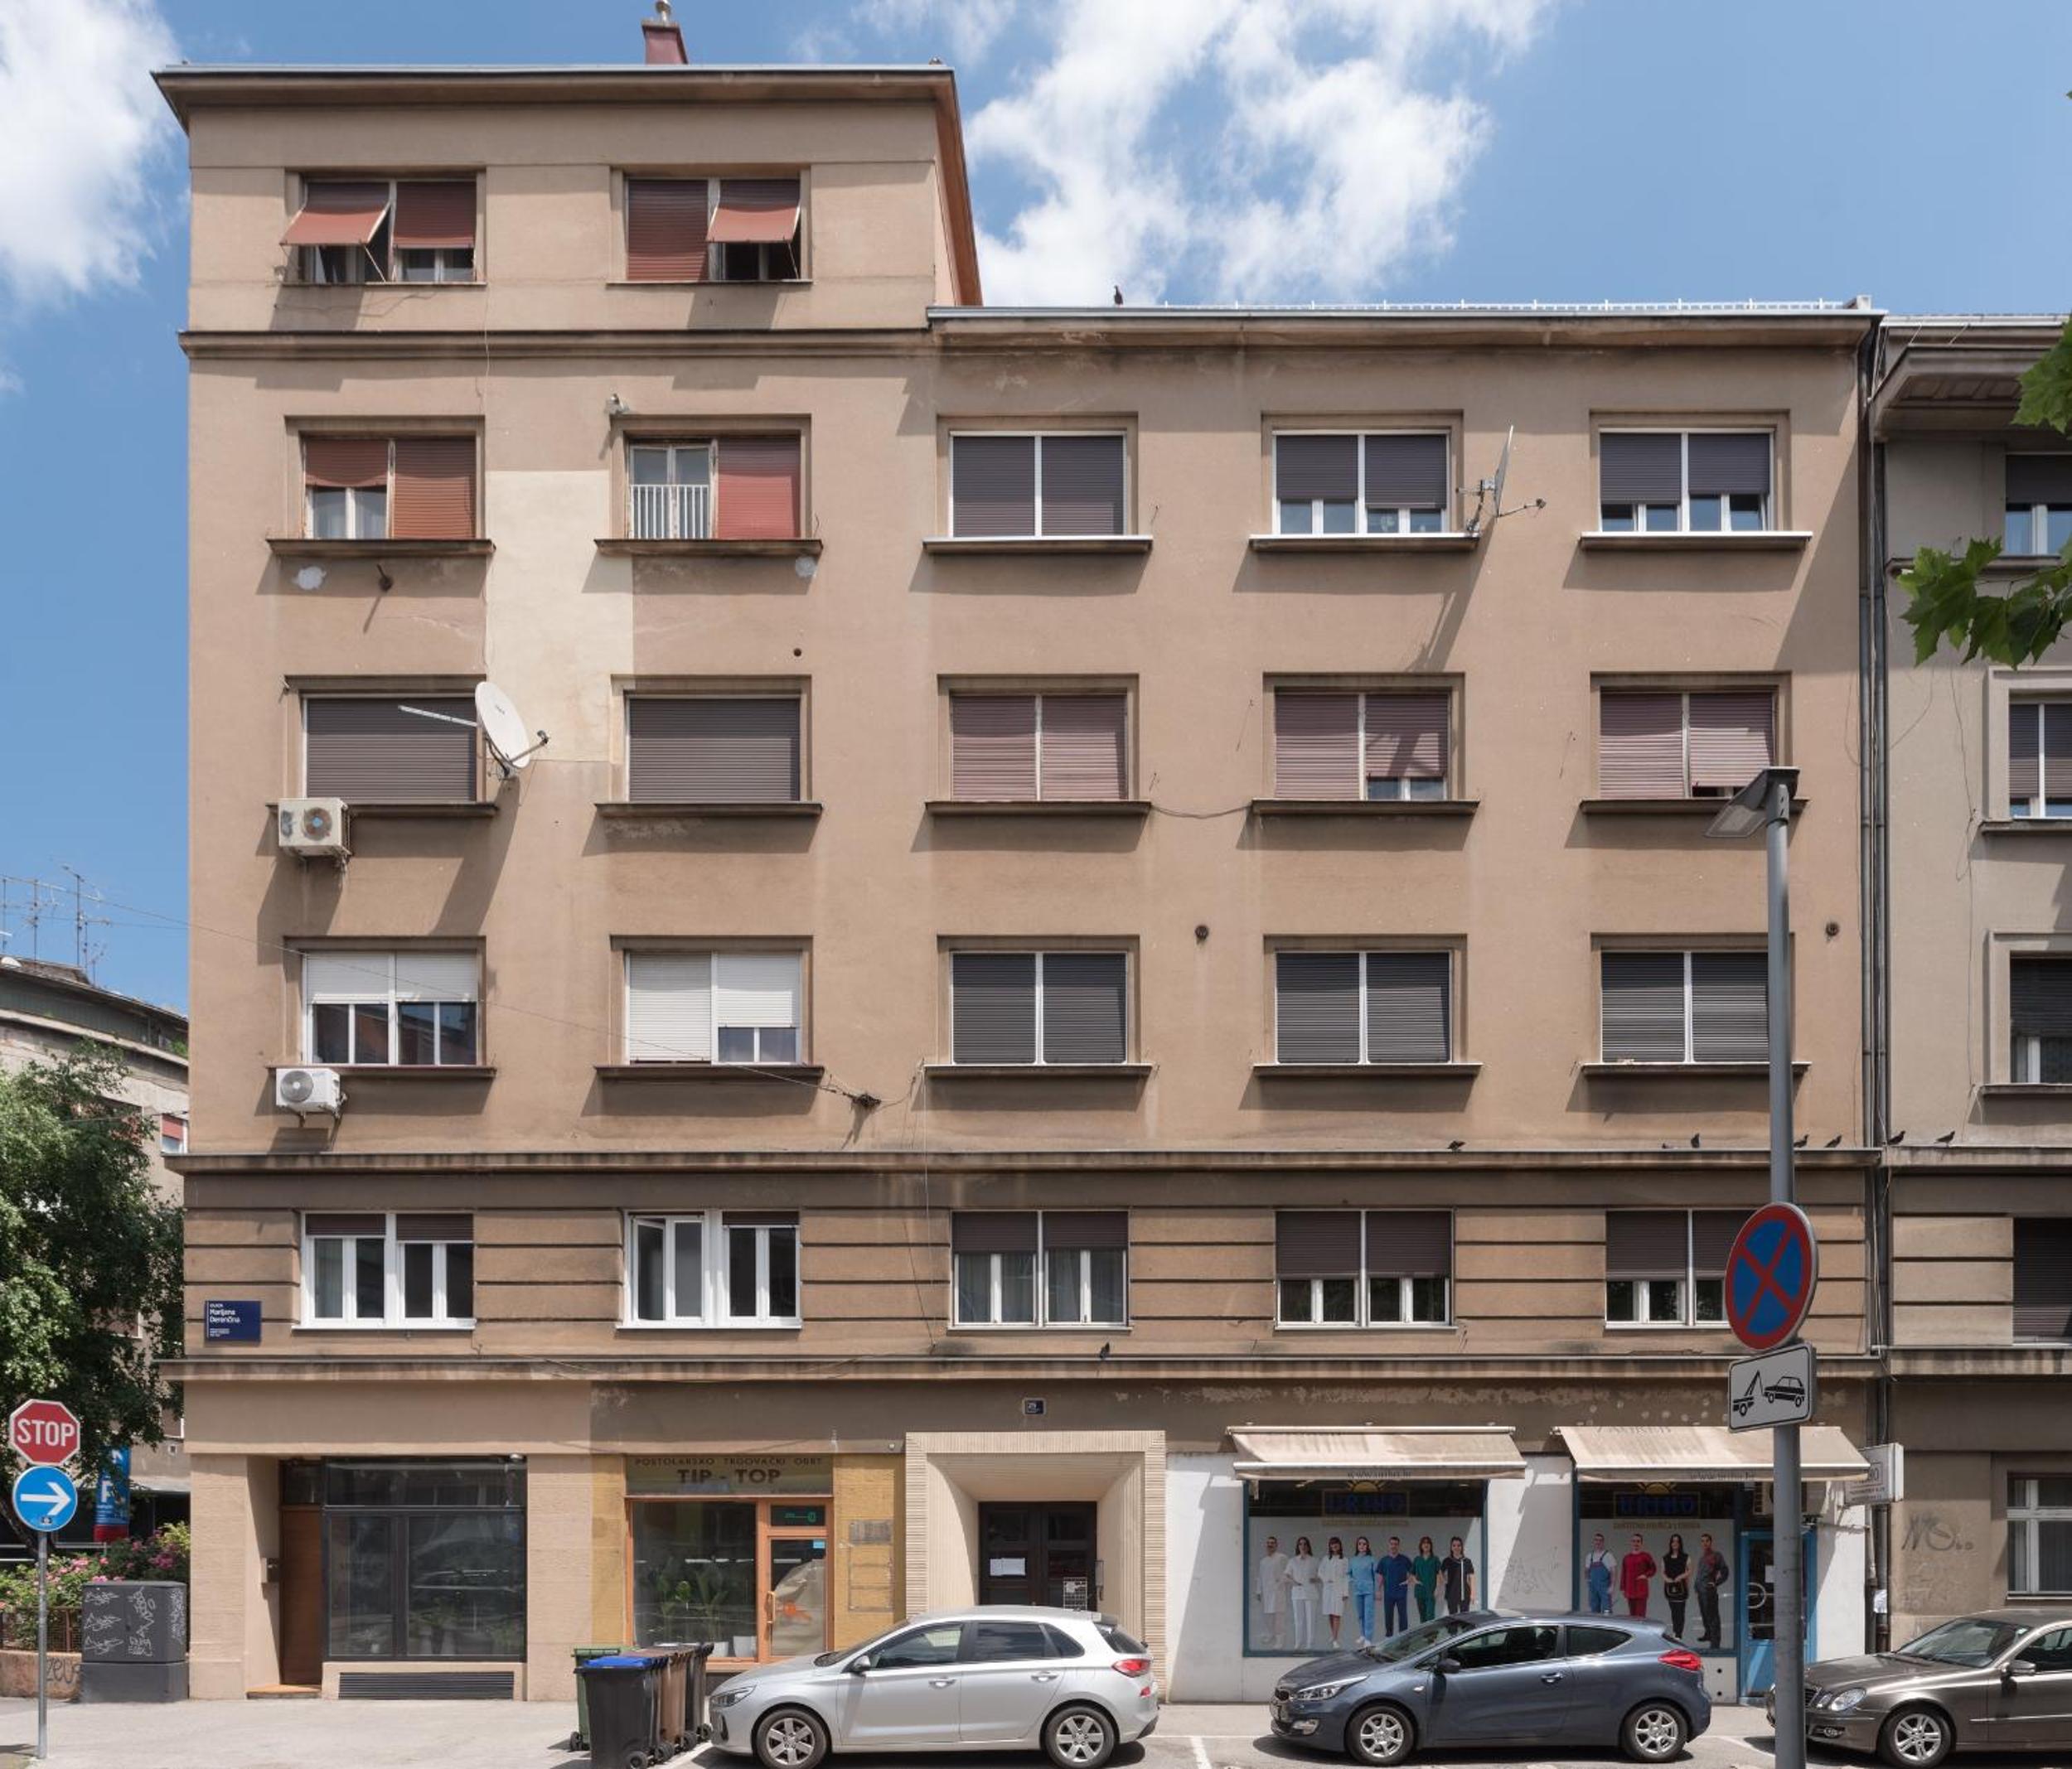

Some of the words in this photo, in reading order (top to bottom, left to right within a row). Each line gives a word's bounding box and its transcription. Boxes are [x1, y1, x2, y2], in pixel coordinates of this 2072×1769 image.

[17, 1418, 75, 1447] STOP
[676, 1469, 713, 1484] TIP
[734, 1468, 781, 1484] TOP
